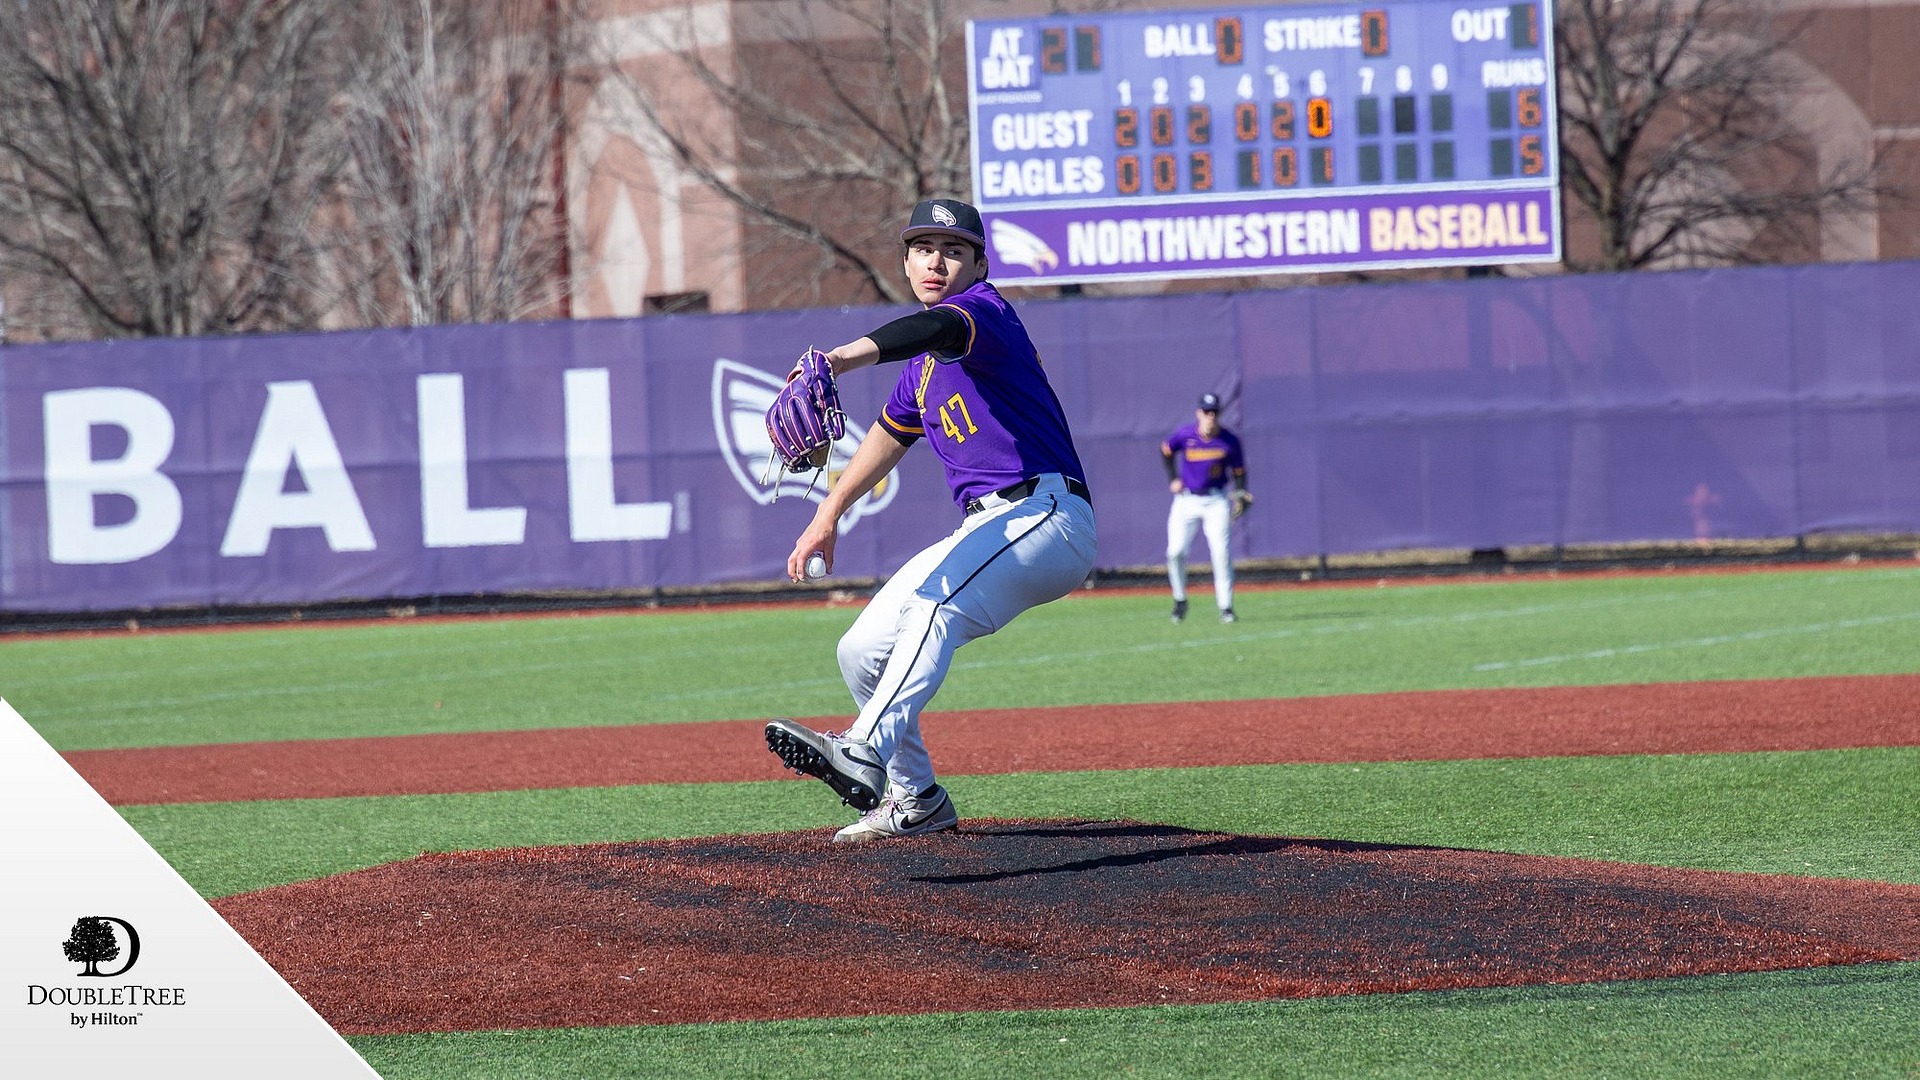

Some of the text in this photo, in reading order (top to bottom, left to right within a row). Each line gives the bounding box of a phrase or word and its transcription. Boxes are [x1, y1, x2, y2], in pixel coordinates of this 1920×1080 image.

[988, 27, 1024, 60] AT
[1143, 23, 1216, 58] BALL
[1216, 17, 1243, 64] 0
[1263, 15, 1361, 52] STRIKE
[1361, 10, 1388, 56] 0
[1451, 7, 1510, 42] OUT
[981, 55, 1034, 89] BAT
[1118, 63, 1448, 106] 1 2 3 4 5 6 7 8 9
[1481, 58, 1546, 88] RUNS
[992, 110, 1094, 152] GUEST
[1116, 88, 1542, 147] 2 0 2 0 2 0 6
[981, 156, 1105, 198] EAGLES
[1117, 155, 1140, 193] 0
[1153, 153, 1176, 192] 0
[1189, 151, 1213, 190] 3
[1273, 146, 1297, 186] 0
[1519, 135, 1544, 175] 5
[1067, 201, 1548, 267] NORTHWESTERN BASEBALL
[938, 392, 979, 444] 47
[43, 367, 673, 566] BALL
